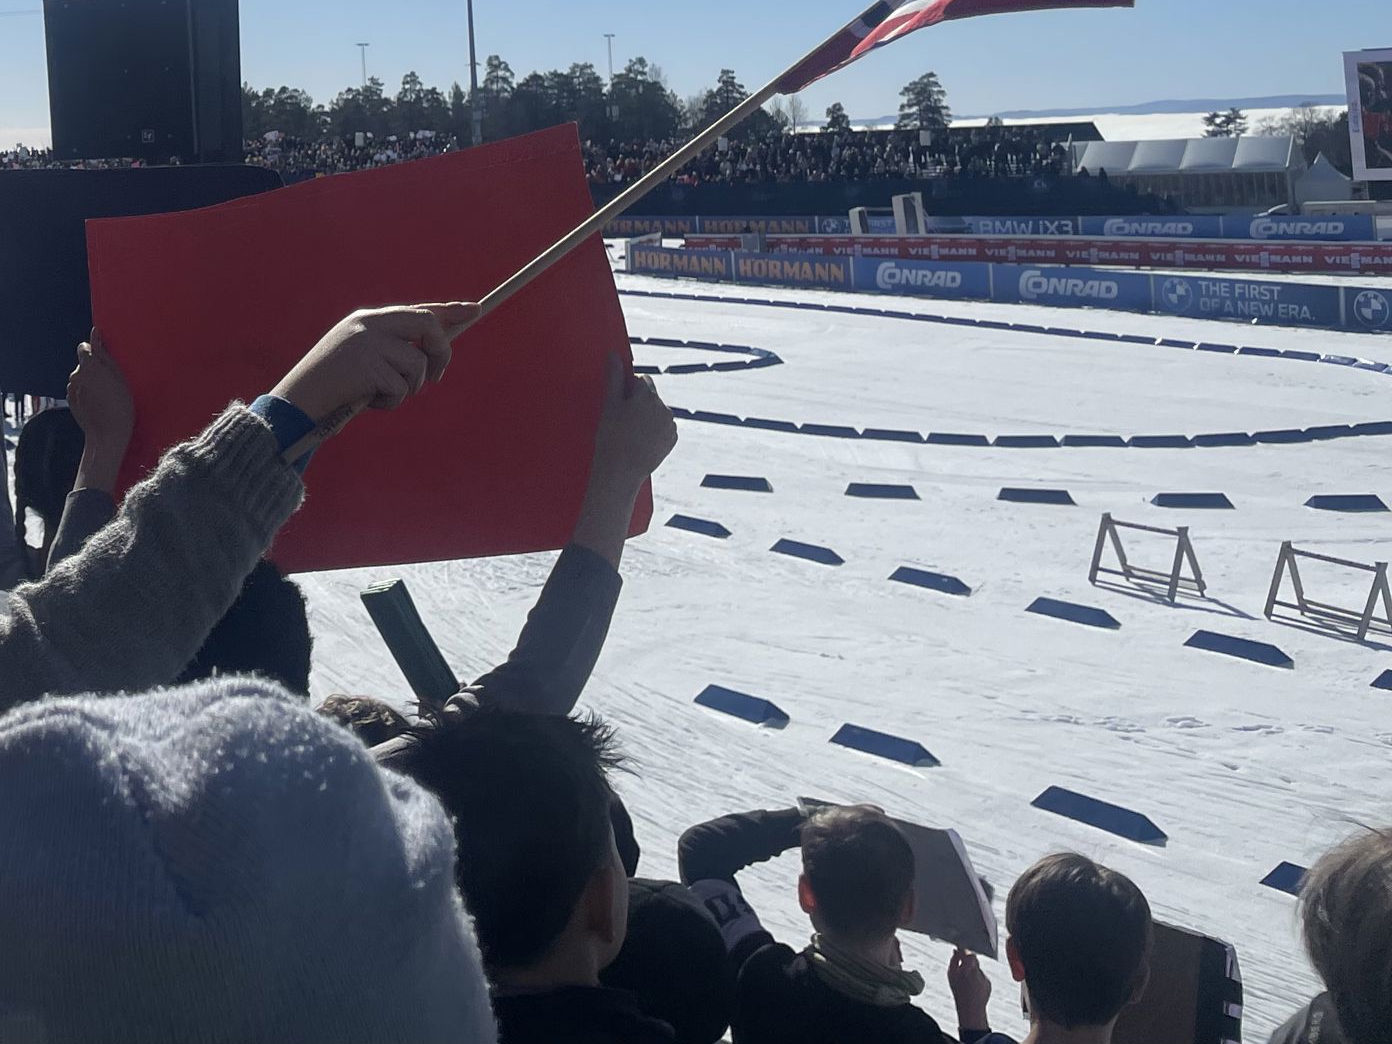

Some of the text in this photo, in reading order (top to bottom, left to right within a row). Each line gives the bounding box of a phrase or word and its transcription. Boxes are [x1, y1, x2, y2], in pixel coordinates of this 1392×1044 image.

[979, 220, 1073, 235] BMW iX3
[1104, 218, 1193, 236] CONRAD
[1249, 218, 1344, 238] CONRAD
[739, 258, 844, 283] HÖRMANN
[1324, 253, 1392, 268] VIESSMAN
[876, 262, 962, 289] CONRAD
[1019, 270, 1118, 299] CONRAD
[1198, 281, 1230, 297] THE
[1235, 284, 1281, 301] FIRST
[1200, 298, 1316, 320] OF A NEW ERA.
